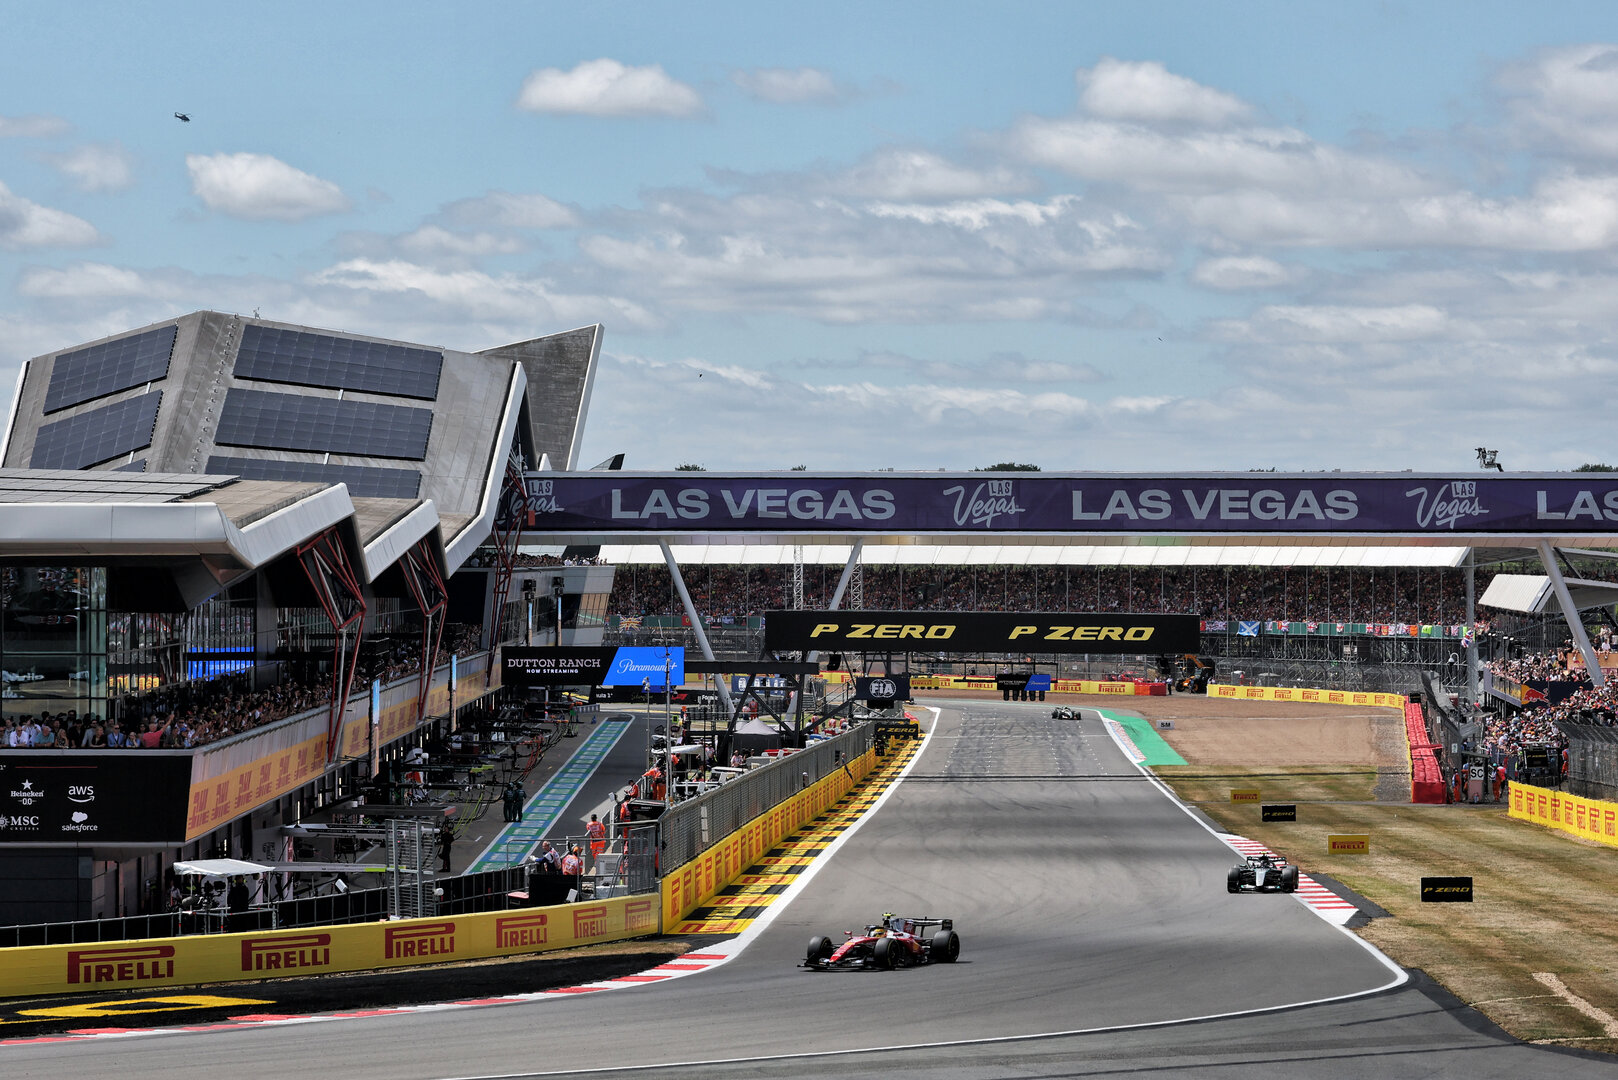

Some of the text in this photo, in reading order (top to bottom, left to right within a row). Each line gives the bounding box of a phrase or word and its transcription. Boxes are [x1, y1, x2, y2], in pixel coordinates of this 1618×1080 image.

[530, 481, 552, 495] LAS
[989, 481, 1012, 495] LAS
[1453, 482, 1475, 496] LAS
[611, 489, 896, 519] LAS VEGAS
[943, 483, 1026, 528] Vegas
[1072, 489, 1359, 520] LAS VEGAS
[1406, 484, 1489, 529] Vegas
[810, 623, 957, 639] P ZERO
[1008, 625, 1155, 641] P ZERO
[507, 658, 601, 668] DUTTON RANCH
[1054, 682, 1082, 692] PIRELLI
[1098, 684, 1126, 693] PIRELLI
[1470, 768, 1484, 778] SC
[68, 785, 94, 795] aws
[10, 815, 39, 826] MSC
[61, 823, 98, 832] salesforce
[1332, 841, 1365, 850] PIRELLI
[573, 906, 607, 939] PIRELLI
[624, 900, 651, 931] PIRELLI
[496, 914, 547, 948] PIRELLI
[385, 922, 455, 959] PIRELLI
[241, 933, 331, 971] PIRELLI
[67, 945, 175, 984] PIRELLI
